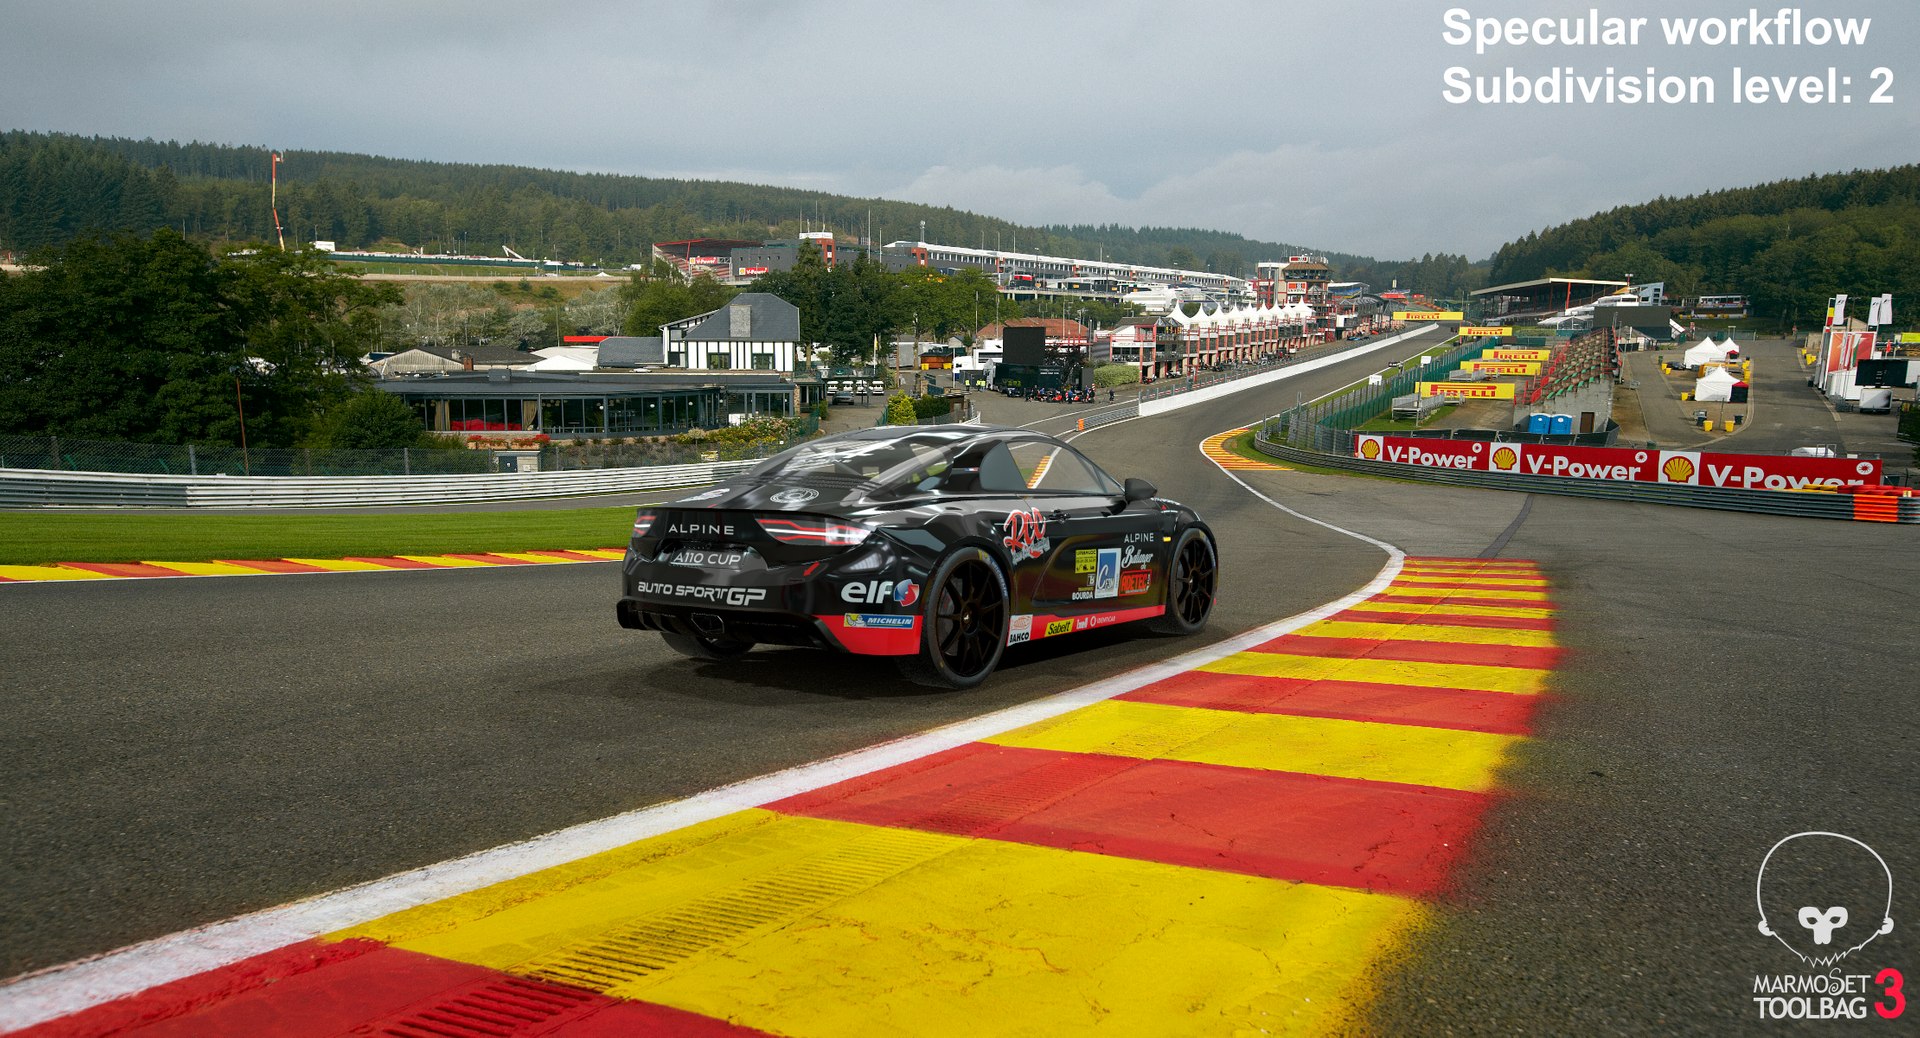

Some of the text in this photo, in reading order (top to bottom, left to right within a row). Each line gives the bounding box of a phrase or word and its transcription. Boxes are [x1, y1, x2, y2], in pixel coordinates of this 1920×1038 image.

[1406, 312, 1440, 320] PIRELLI
[1493, 351, 1539, 360] PIRELLI
[1387, 445, 1477, 470] V-Power
[1526, 454, 1641, 481] V-Power
[668, 523, 735, 536] ALPINE
[1124, 532, 1155, 543] ALPINE
[673, 552, 742, 566] A110 CUP
[840, 580, 894, 604] elf
[1072, 591, 1094, 601] BOURDA
[867, 617, 913, 625] MICHELIN
[1047, 620, 1071, 636] Sabelt
[1009, 632, 1030, 643] BAHCO
